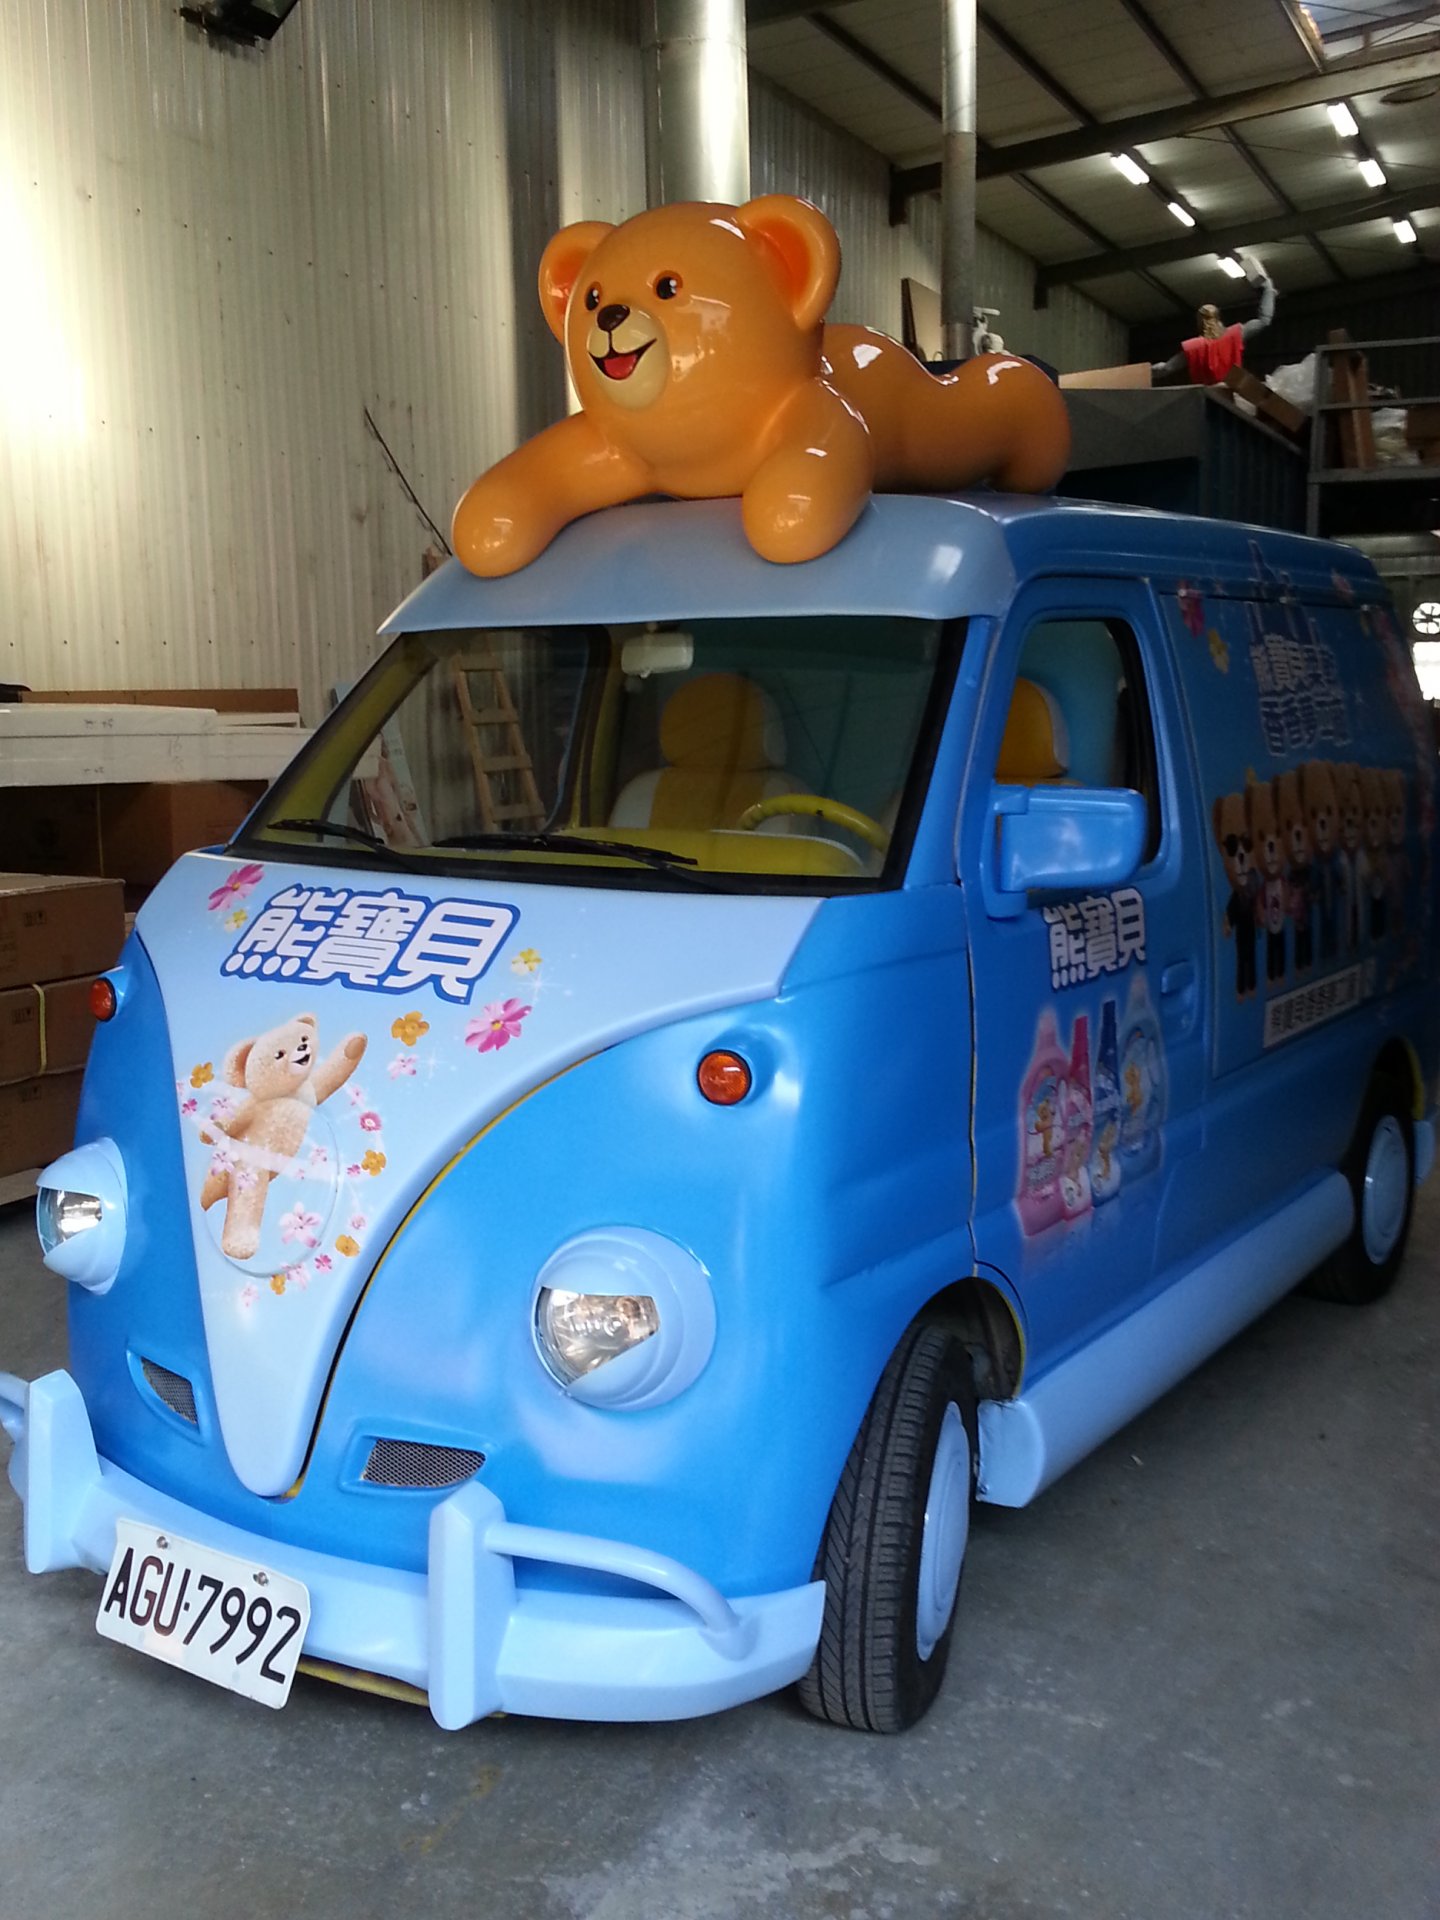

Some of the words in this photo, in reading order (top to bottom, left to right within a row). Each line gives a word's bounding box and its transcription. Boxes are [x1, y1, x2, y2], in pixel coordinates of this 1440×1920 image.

[222, 886, 515, 1000] 熊寶貝
[1043, 887, 1146, 989] 熊寶貝
